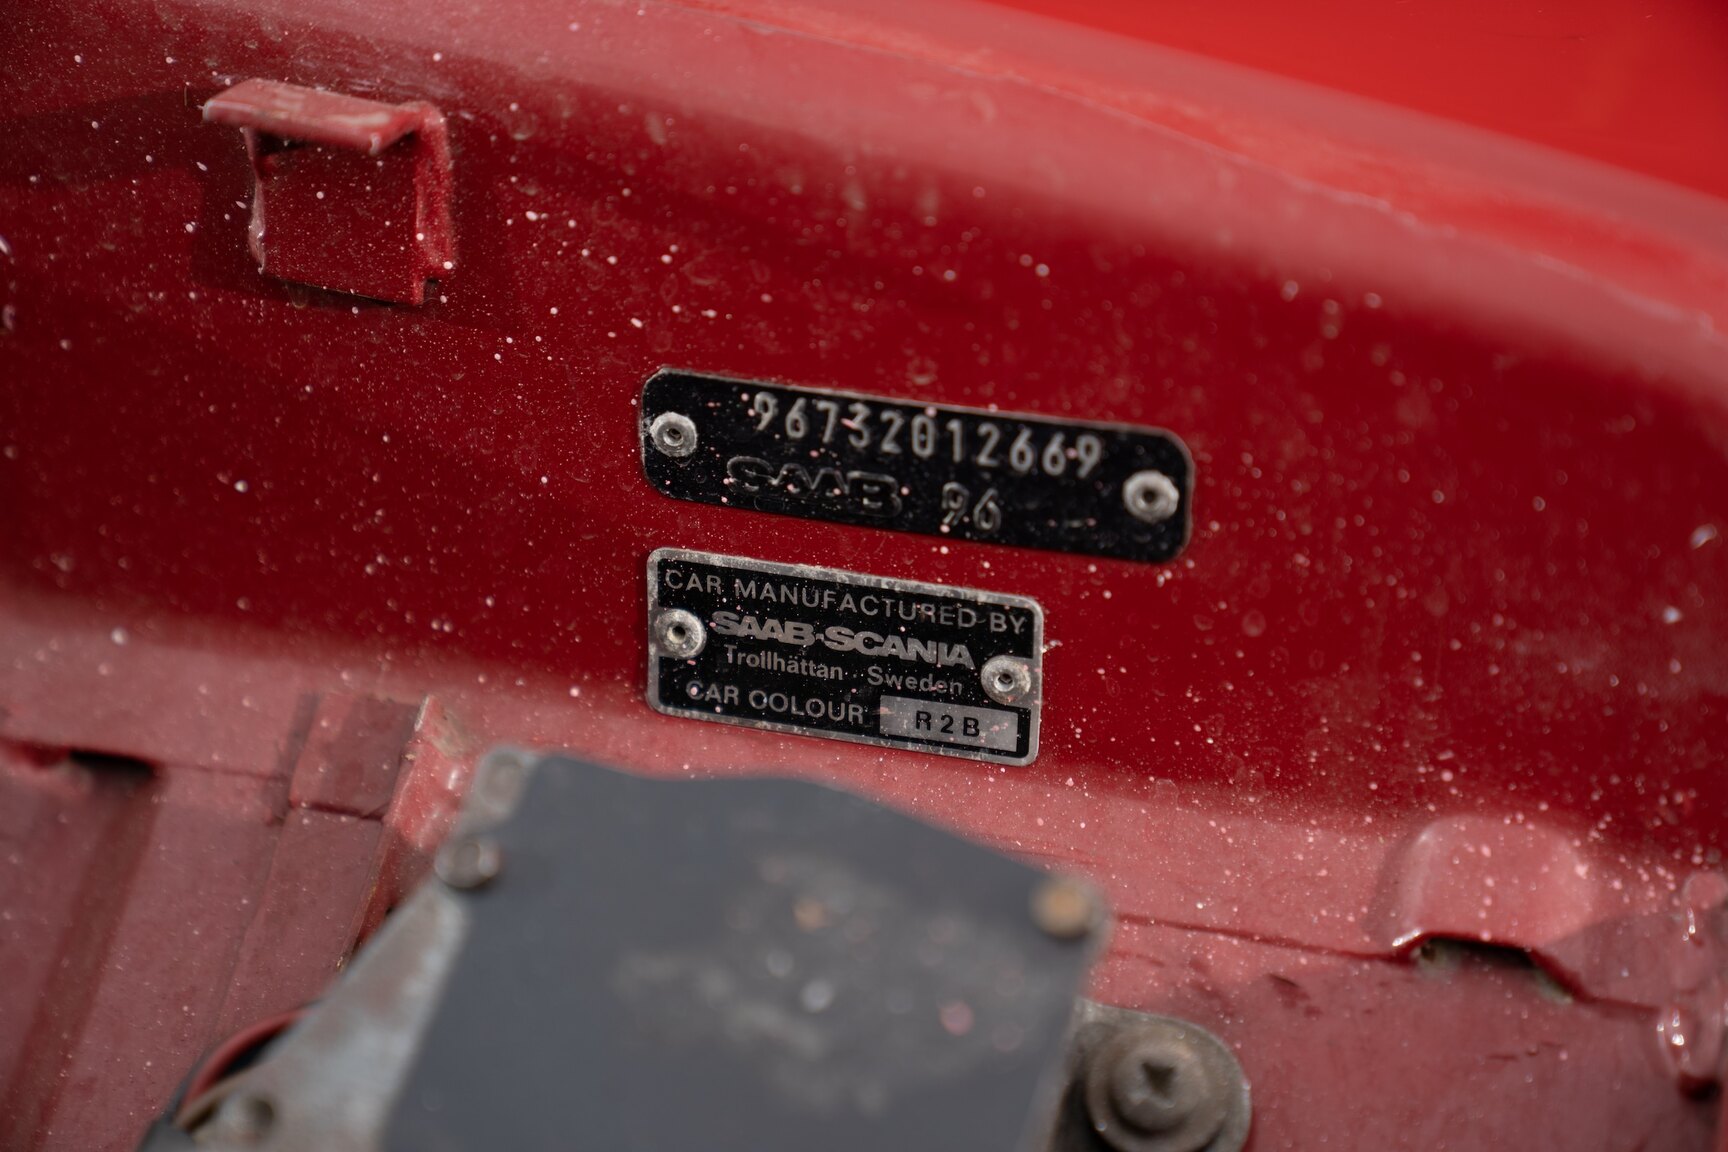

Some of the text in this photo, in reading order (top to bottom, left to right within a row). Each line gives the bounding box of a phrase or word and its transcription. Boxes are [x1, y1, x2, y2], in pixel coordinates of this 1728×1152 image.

[754, 391, 1101, 479] 96732012669
[942, 481, 1000, 531] 96
[665, 569, 1026, 634] CAR MANUFACTURED BY
[724, 644, 963, 696] Trollhättan Sweden
[686, 680, 740, 706] CAR
[749, 689, 864, 725] COLOUR
